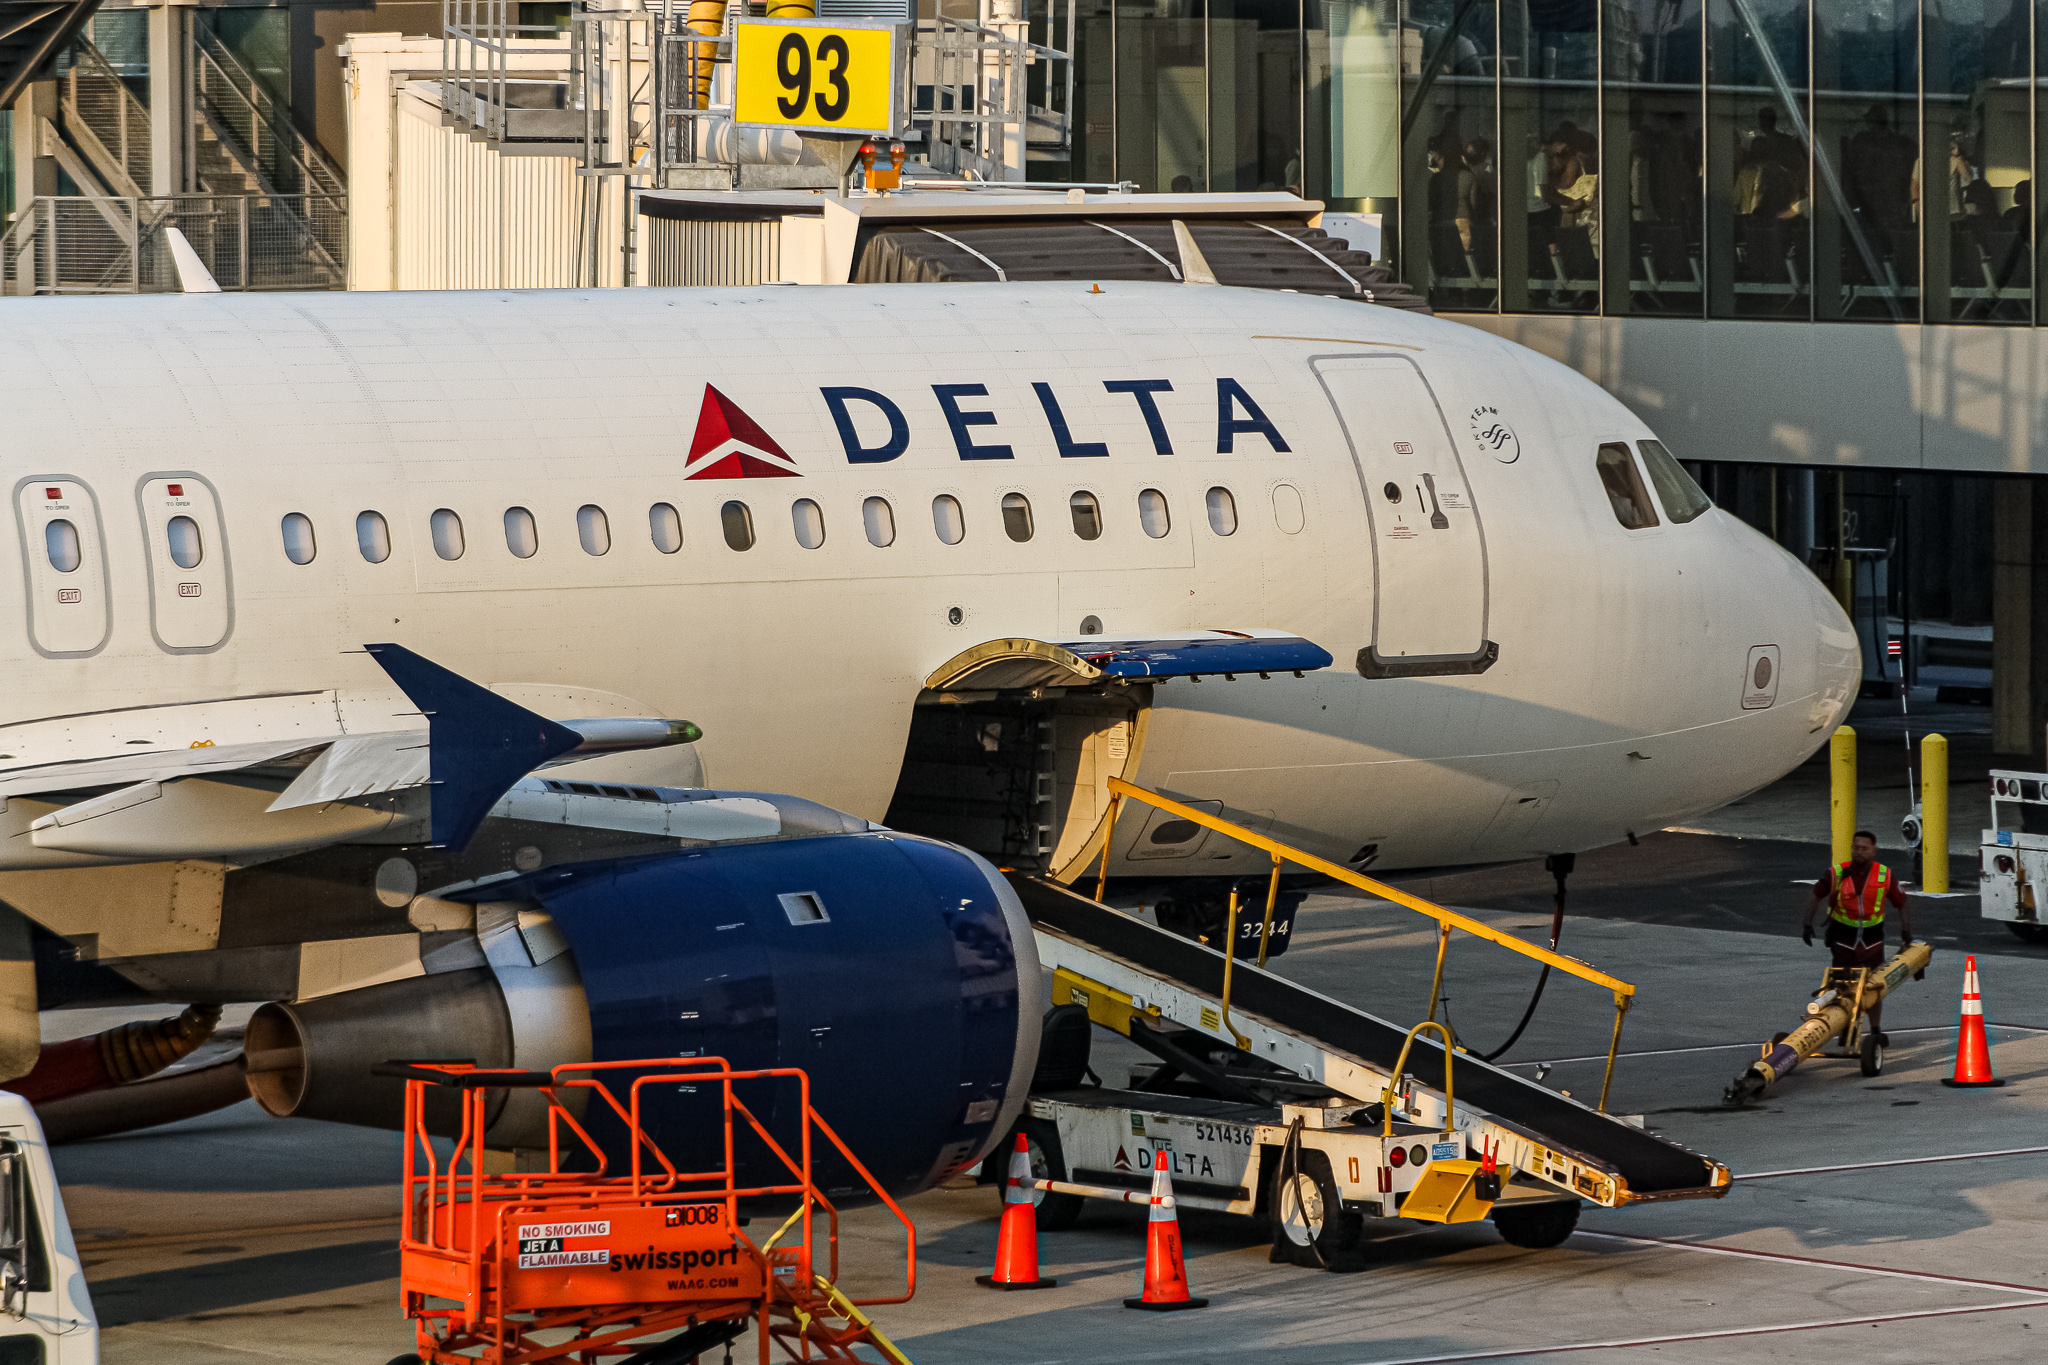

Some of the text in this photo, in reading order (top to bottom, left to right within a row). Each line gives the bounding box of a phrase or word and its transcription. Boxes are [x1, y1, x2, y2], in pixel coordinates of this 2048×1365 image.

[776, 32, 850, 122] 93
[819, 377, 1292, 464] DELTA
[1470, 405, 1499, 451] SKYTEAM
[60, 591, 79, 601] EXIT
[180, 585, 199, 595] EXIT
[1241, 920, 1289, 938] 3244
[1196, 1124, 1251, 1146] 521436
[1138, 1148, 1214, 1177] DLTA
[522, 1222, 607, 1238] NO SMOKING
[523, 1239, 559, 1253] JET A
[520, 1252, 607, 1267] FLAMMABLE
[610, 1244, 739, 1274] swissport
[1167, 1233, 1181, 1282] DELTA
[667, 1278, 739, 1291] WAAG.COM
